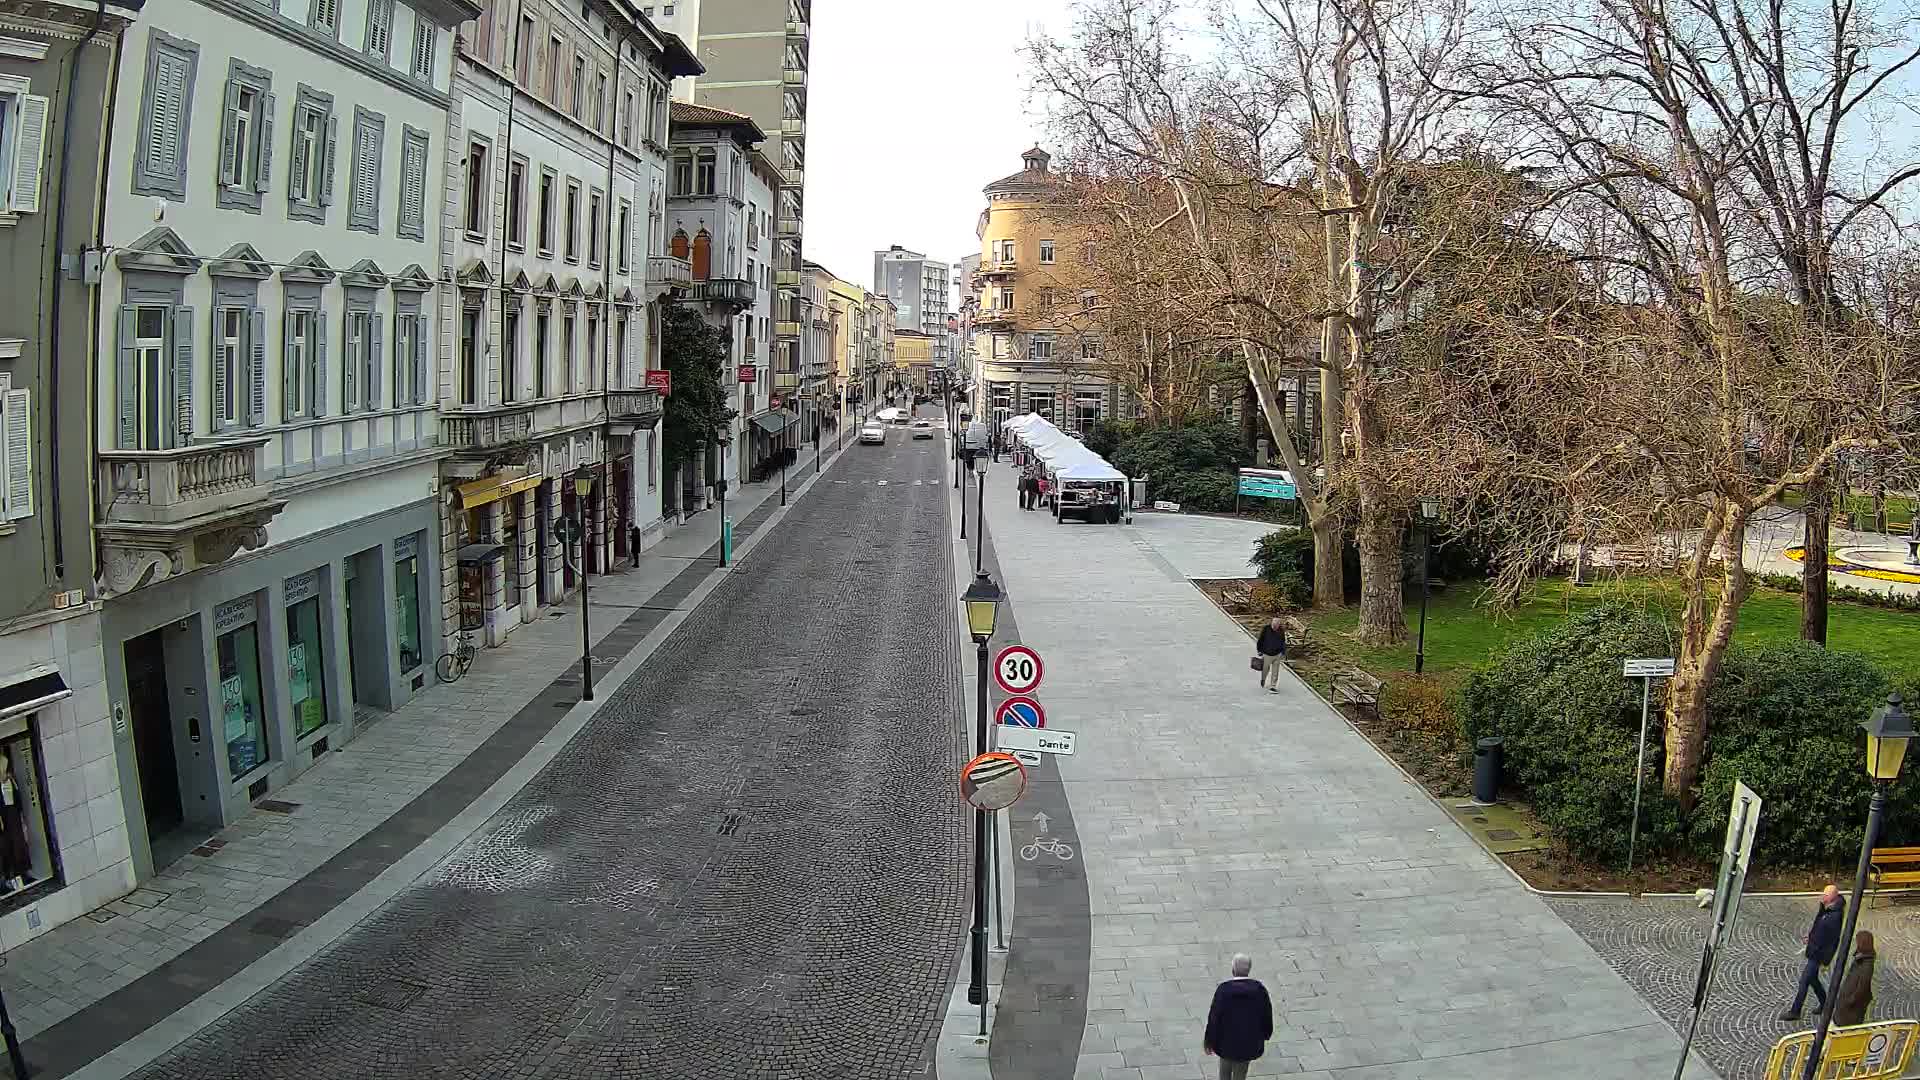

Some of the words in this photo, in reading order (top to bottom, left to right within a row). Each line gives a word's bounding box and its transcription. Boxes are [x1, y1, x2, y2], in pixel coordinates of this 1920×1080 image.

[1005, 658, 1033, 681] 30
[223, 678, 241, 700] 130
[1038, 739, 1070, 750] Dante
